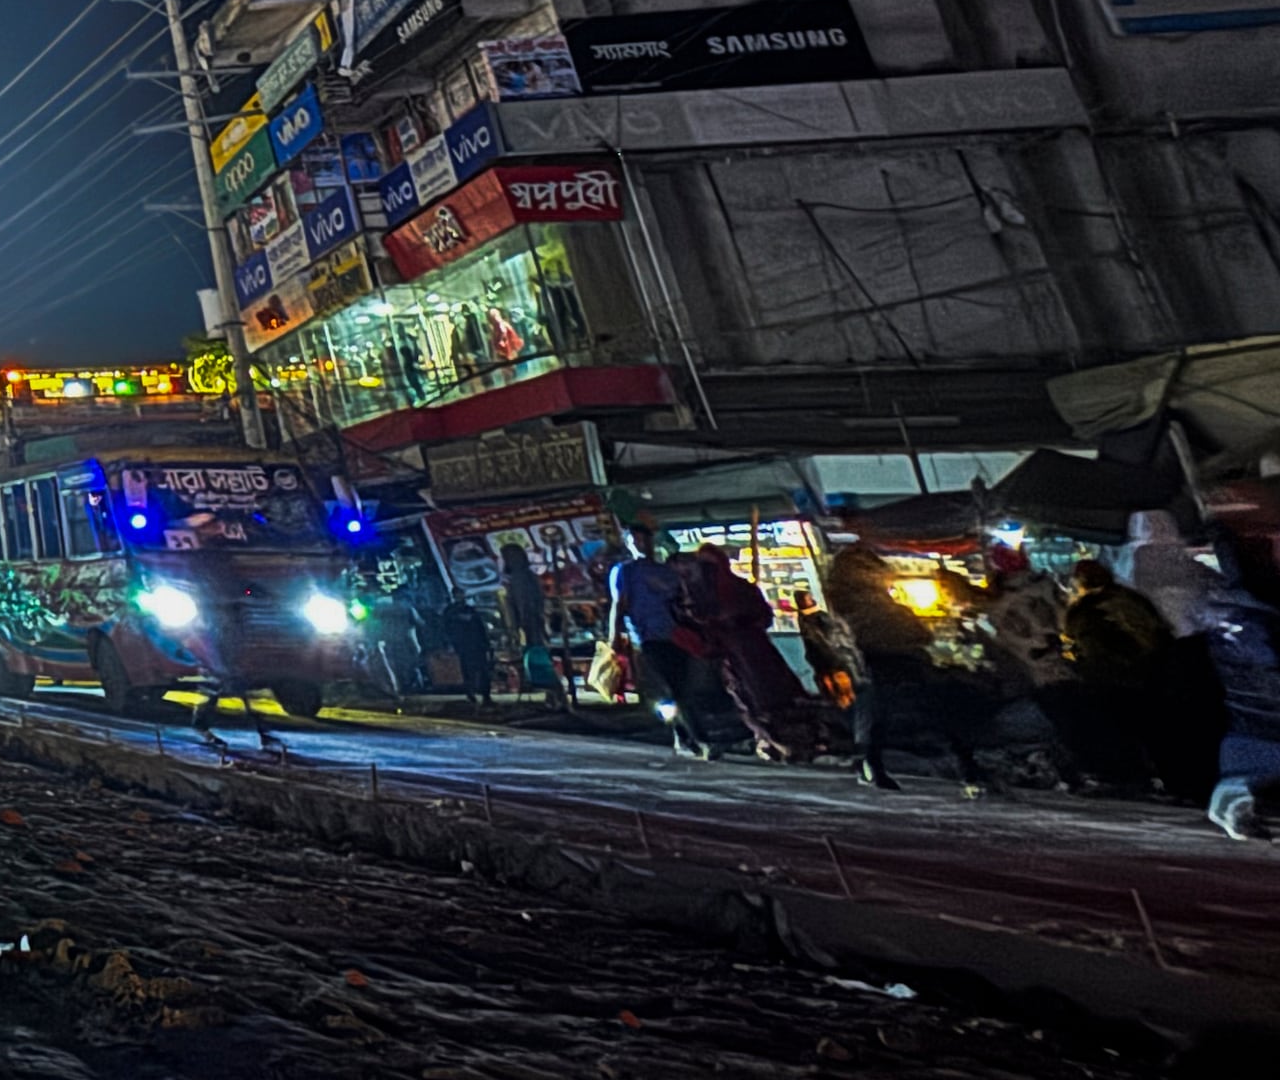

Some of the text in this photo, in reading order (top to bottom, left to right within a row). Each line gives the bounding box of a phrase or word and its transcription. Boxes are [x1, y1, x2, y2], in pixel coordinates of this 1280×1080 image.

[704, 26, 850, 57] SAMSUNG
[276, 107, 312, 147] vivo
[450, 125, 492, 165] vivo
[382, 180, 414, 214] vivo
[508, 169, 620, 213] স্বপ্নপুরী
[310, 204, 347, 248] vivo
[239, 264, 267, 297] vivo
